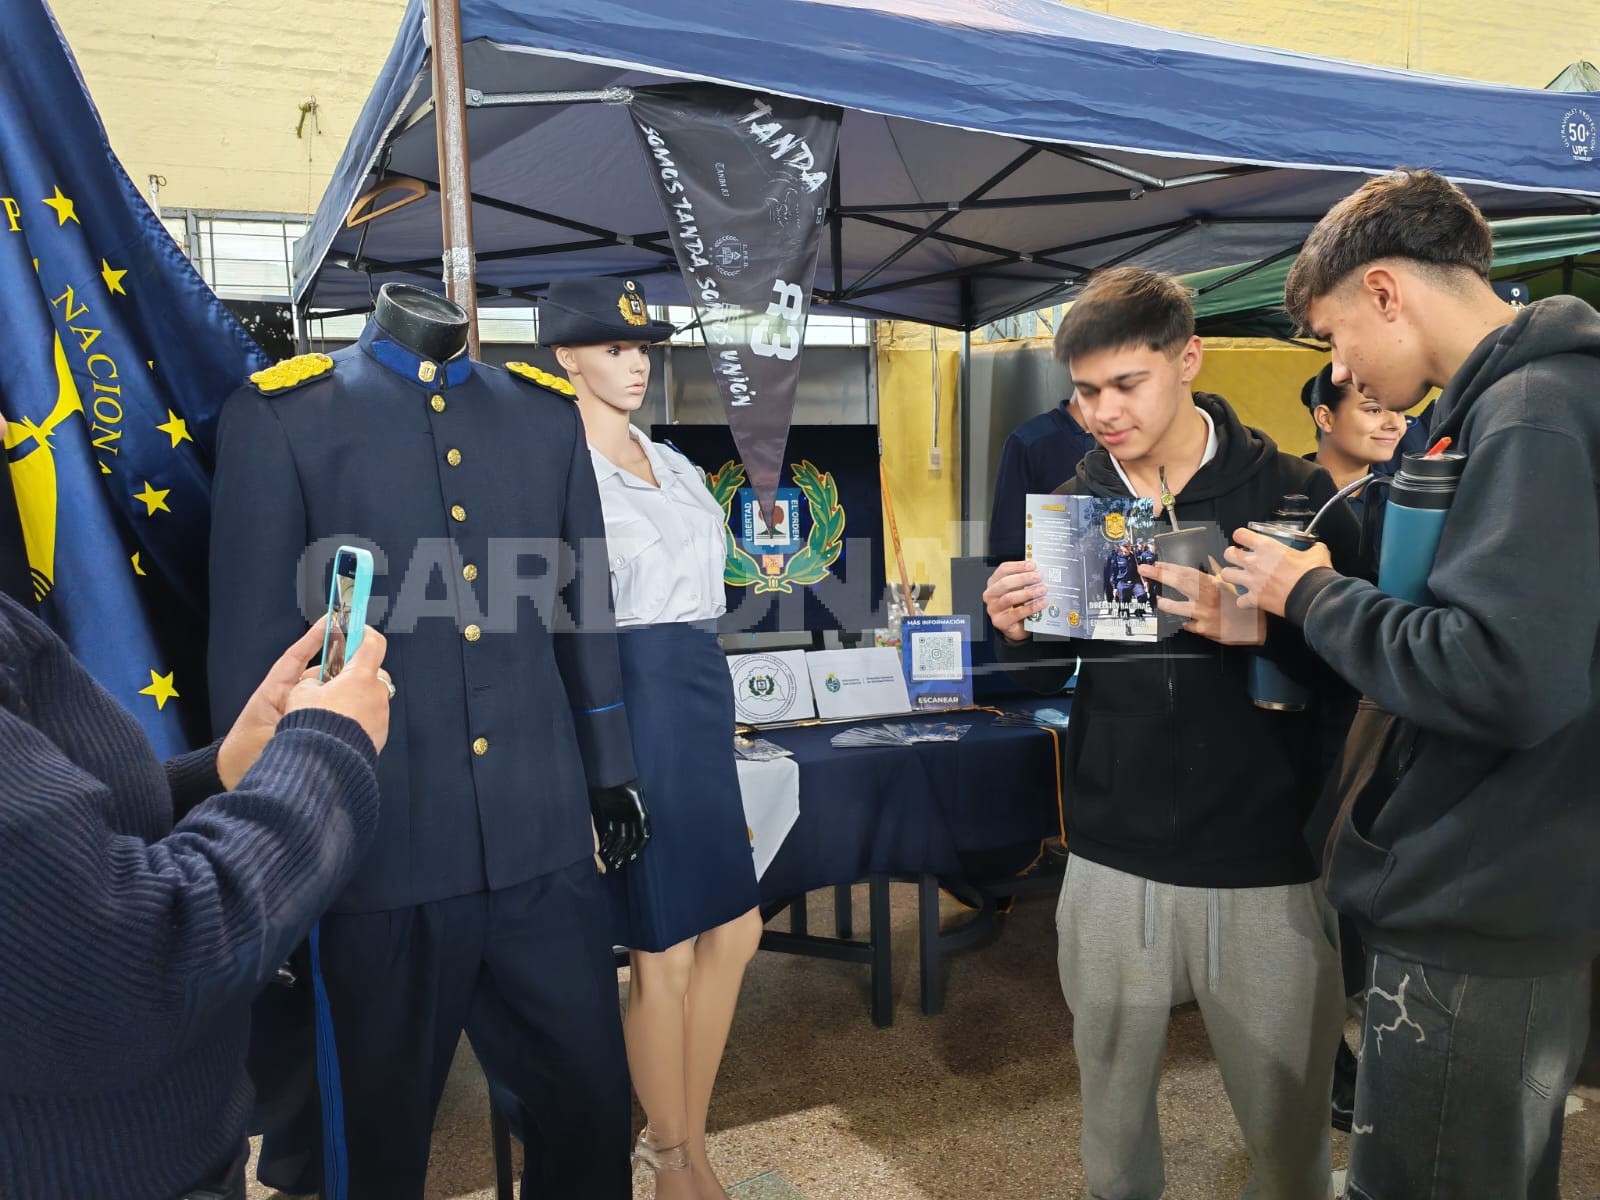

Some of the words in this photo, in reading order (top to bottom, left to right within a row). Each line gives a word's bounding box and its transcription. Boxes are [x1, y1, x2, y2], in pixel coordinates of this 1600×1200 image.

[640, 123, 684, 194] SOMOS
[736, 98, 828, 193] TANDA
[1572, 145, 1588, 155] UPF
[750, 279, 803, 361] 83
[51, 284, 122, 474] NACION
[744, 502, 753, 541] LIBERTAD
[791, 500, 798, 510] EL
[792, 512, 800, 541] ORDEN
[918, 696, 959, 704] ESCANEAR
